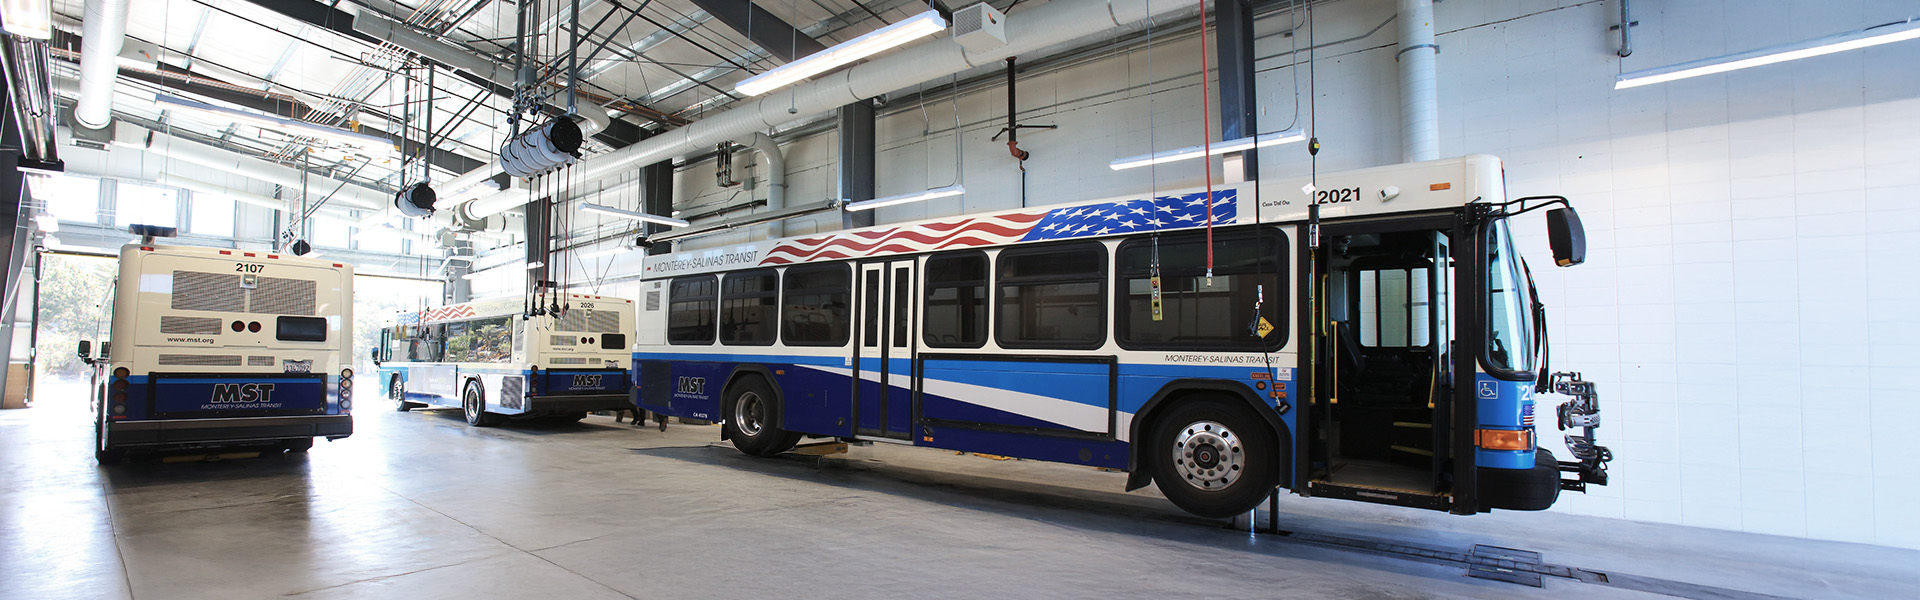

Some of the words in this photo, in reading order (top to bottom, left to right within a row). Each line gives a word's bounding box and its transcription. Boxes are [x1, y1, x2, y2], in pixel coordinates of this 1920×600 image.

[1317, 187, 1361, 204] 2021
[235, 263, 265, 273] 2107
[653, 255, 723, 273] MONTEREY-SALINAS
[725, 250, 758, 265] TRANSIT
[1164, 354, 1244, 364] MONTEREY-SALINAS
[573, 374, 602, 387] MST
[678, 376, 705, 394] MST
[210, 383, 275, 403] MST
